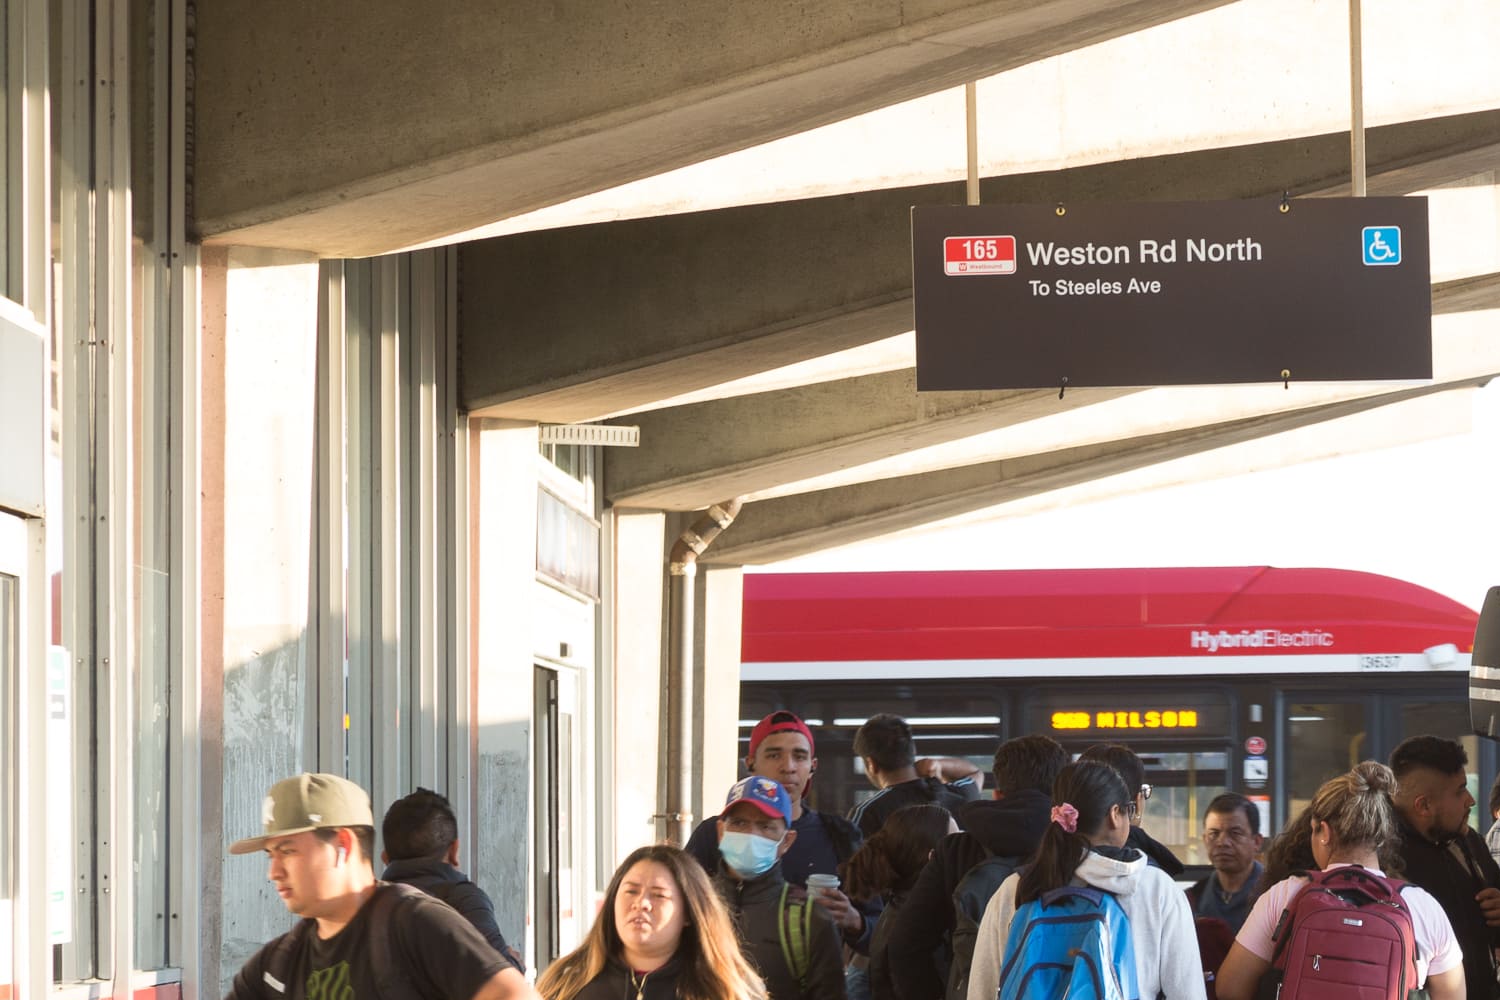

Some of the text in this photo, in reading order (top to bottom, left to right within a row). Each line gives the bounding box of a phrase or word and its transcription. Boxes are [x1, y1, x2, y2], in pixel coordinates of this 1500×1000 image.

[962, 239, 998, 260] 165
[1026, 237, 1263, 266] Weston Rd North
[1028, 277, 1162, 296] To Steeles Ave
[1190, 629, 1334, 652] HybridElectric
